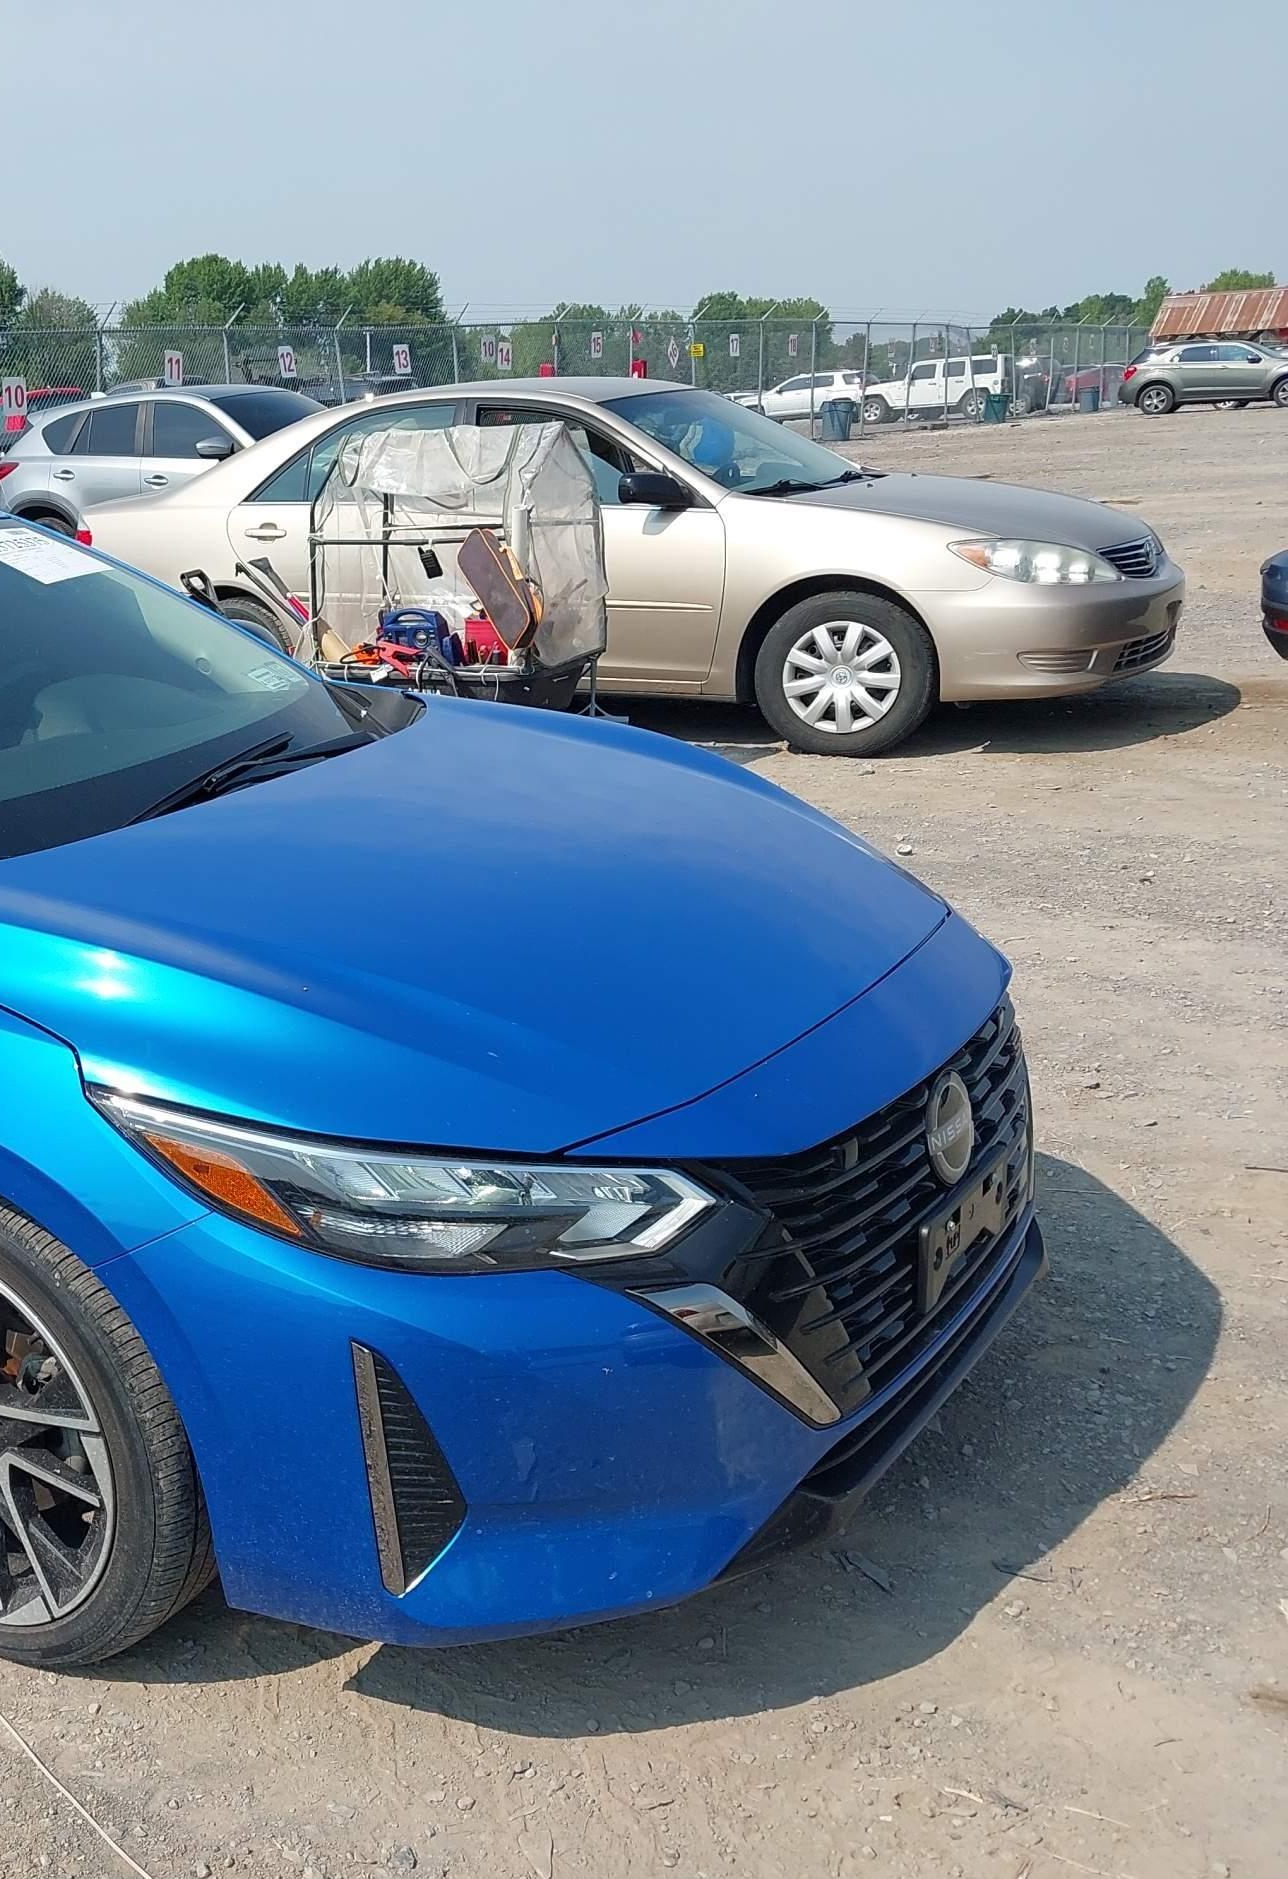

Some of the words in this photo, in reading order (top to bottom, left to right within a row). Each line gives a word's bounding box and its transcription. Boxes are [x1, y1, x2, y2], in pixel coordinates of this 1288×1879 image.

[482, 341, 494, 358] 10
[591, 336, 602, 352] 15
[279, 351, 295, 373] 12
[394, 350, 410, 369] 13
[499, 347, 510, 366] 14
[167, 356, 181, 381] 11
[4, 384, 25, 409] 10
